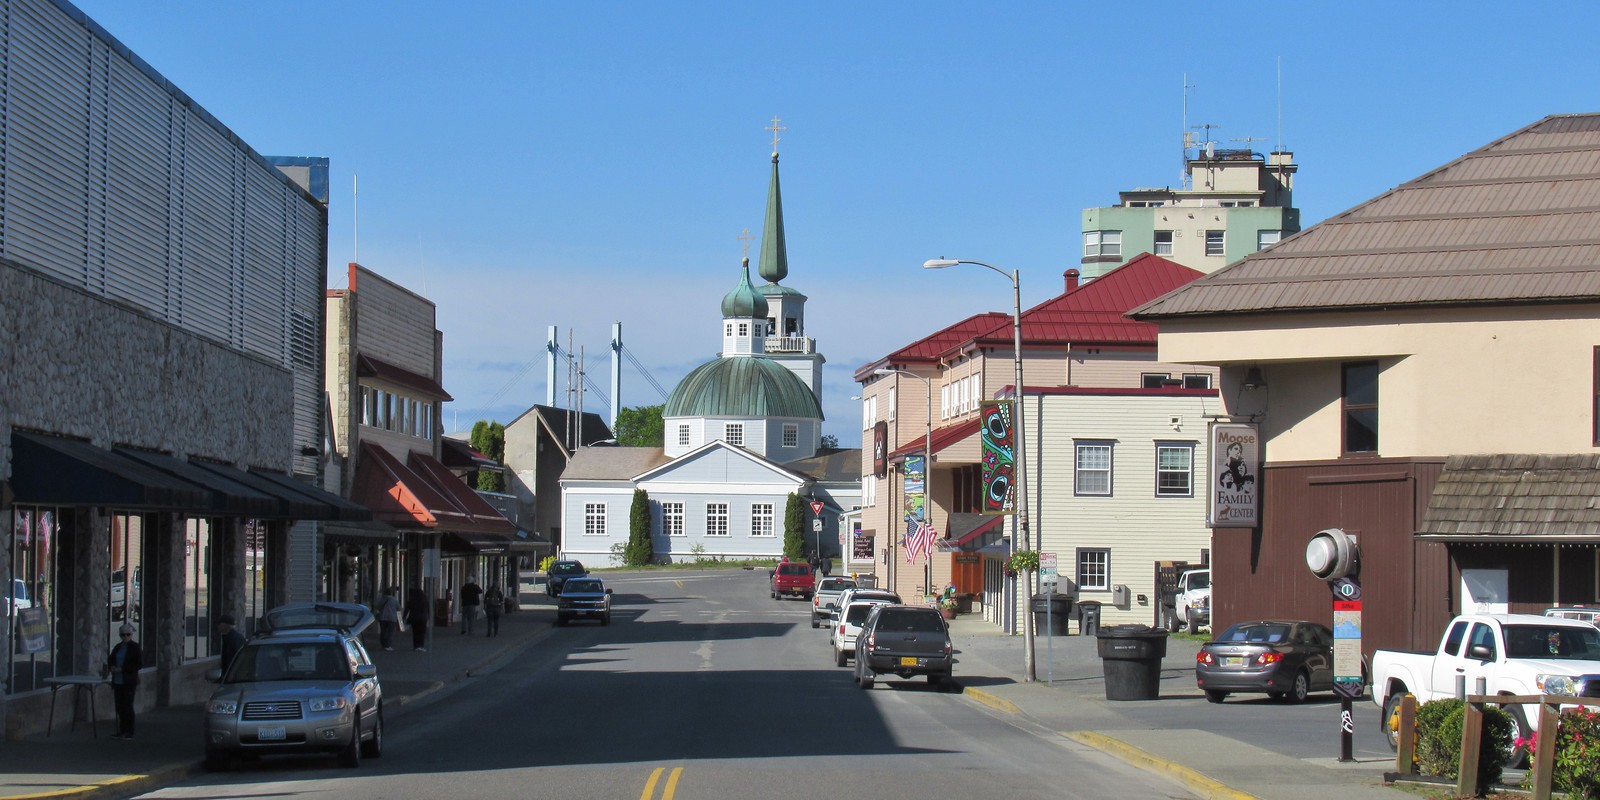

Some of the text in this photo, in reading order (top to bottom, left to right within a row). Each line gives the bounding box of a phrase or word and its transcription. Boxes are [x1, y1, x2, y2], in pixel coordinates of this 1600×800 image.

[1218, 432, 1255, 443] Moose
[1217, 491, 1254, 504] FAMILY
[1230, 508, 1254, 518] CENTER
